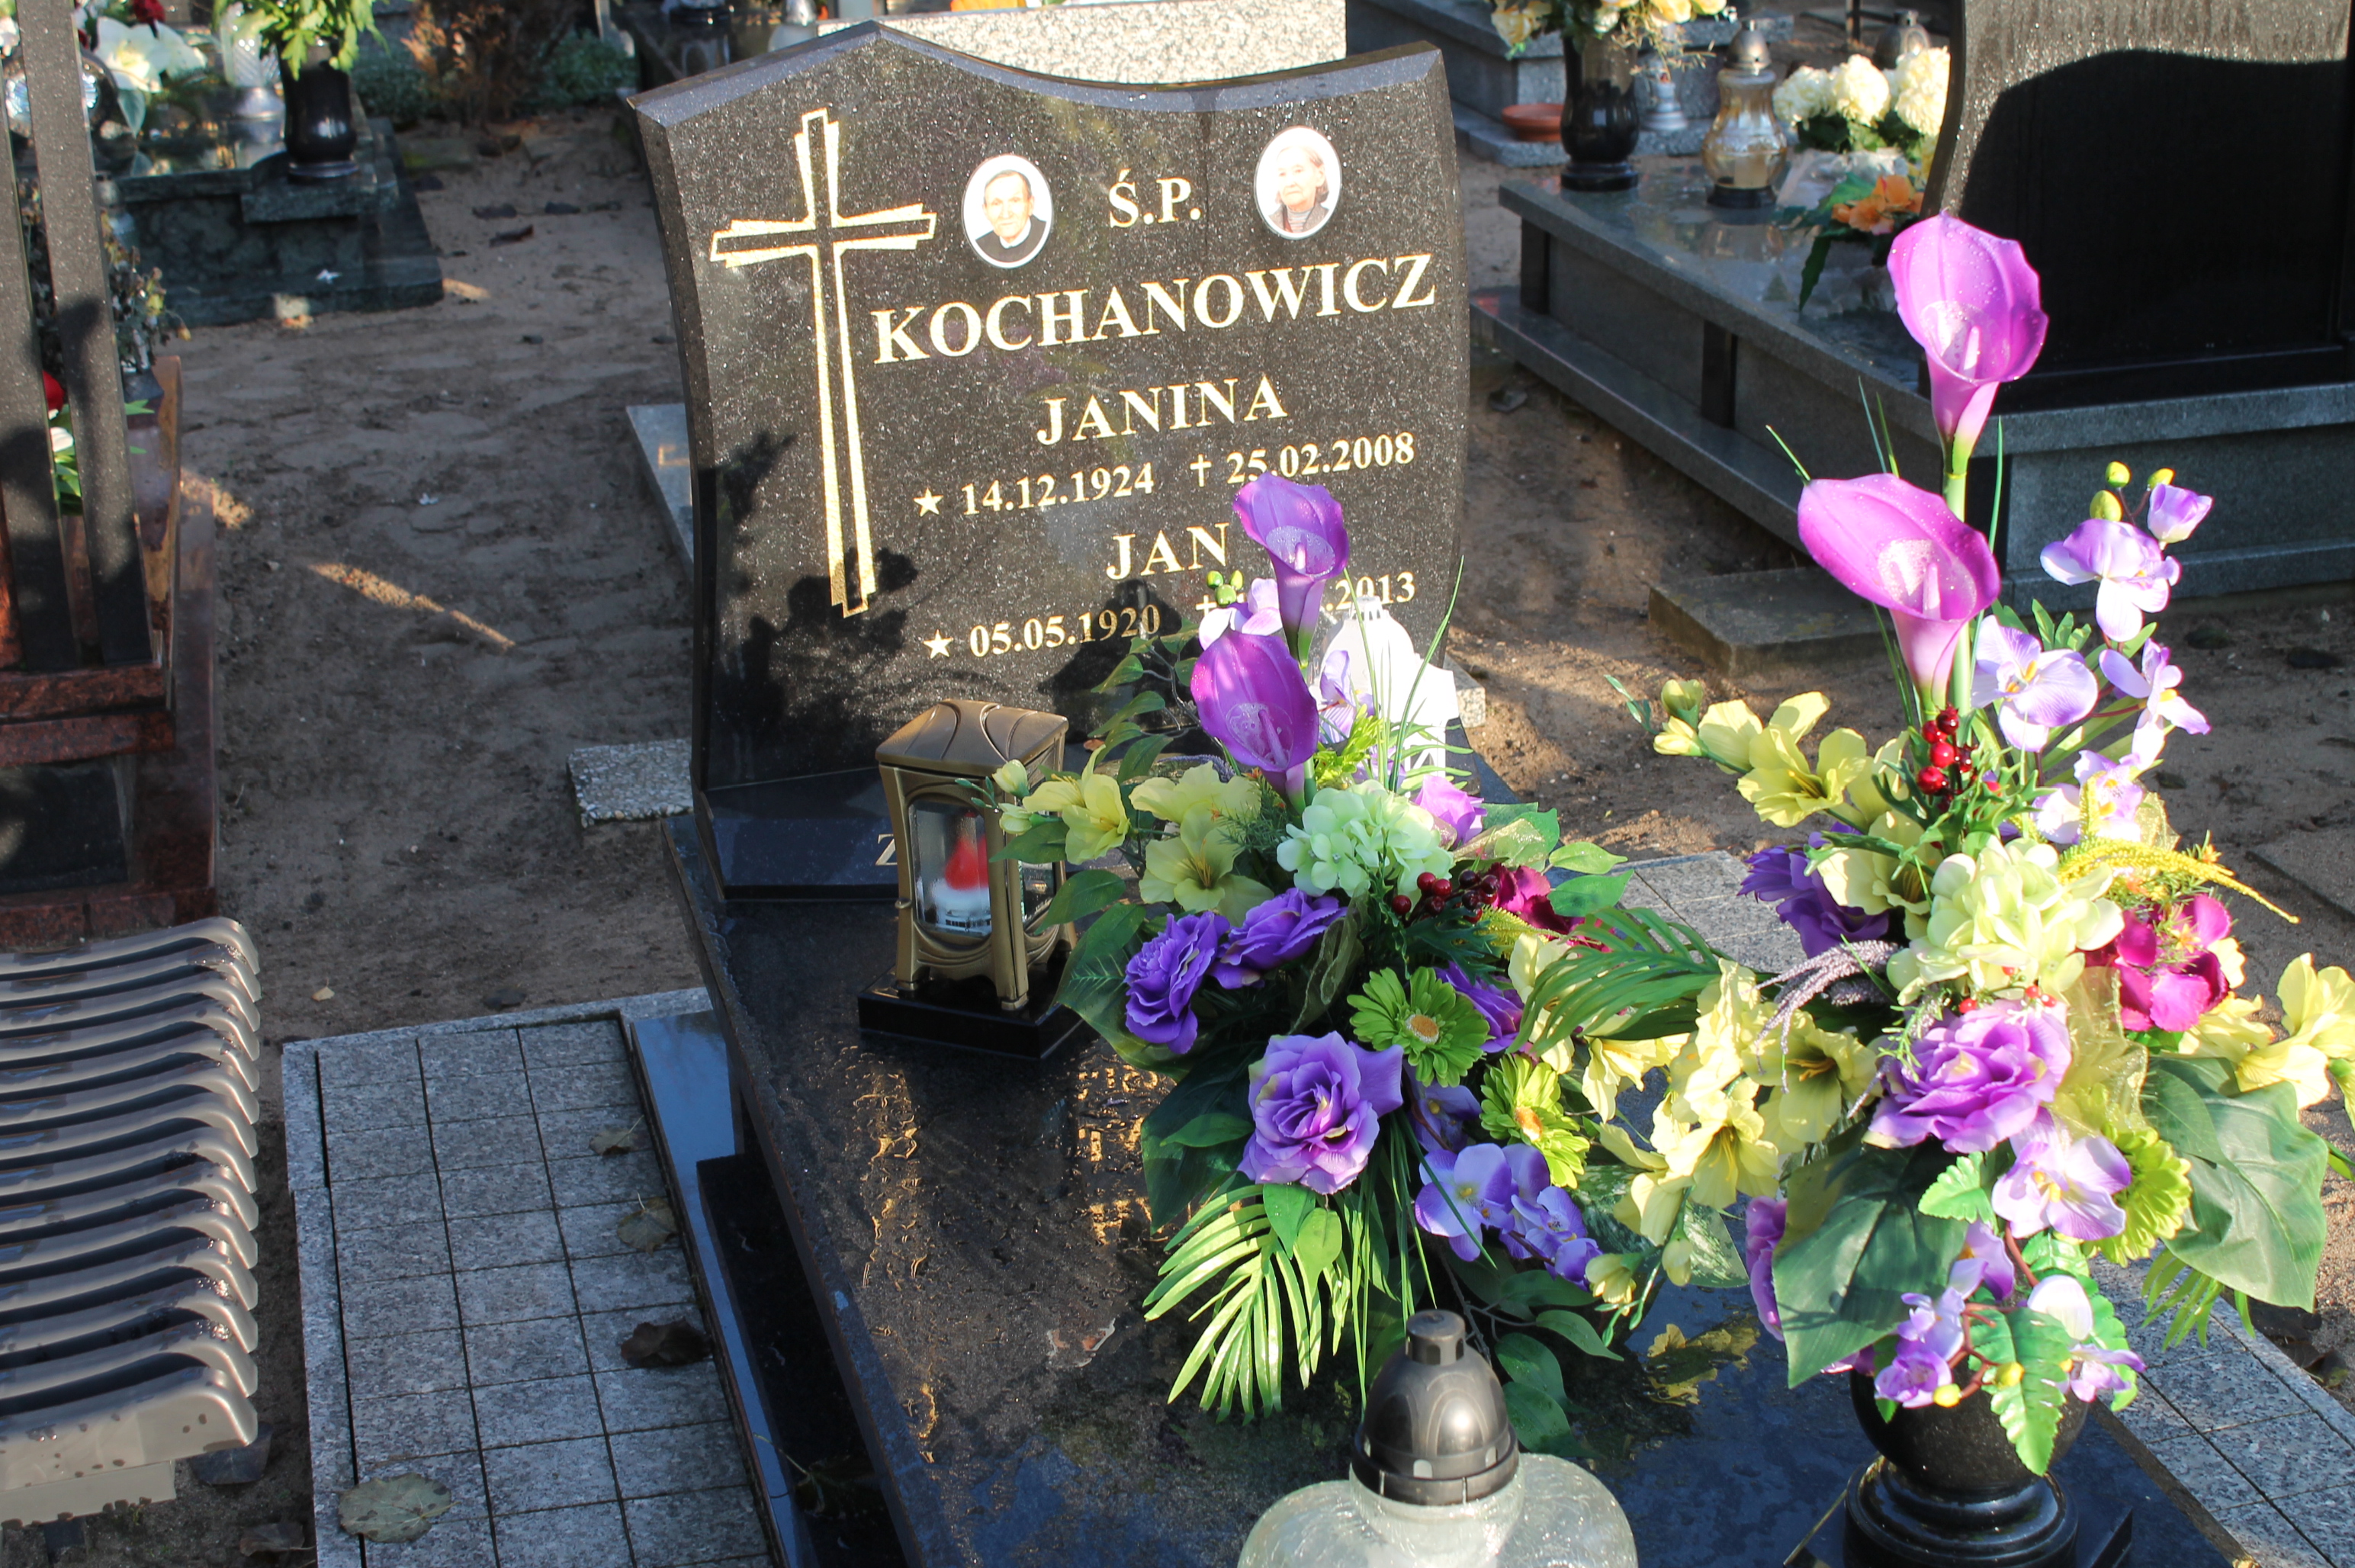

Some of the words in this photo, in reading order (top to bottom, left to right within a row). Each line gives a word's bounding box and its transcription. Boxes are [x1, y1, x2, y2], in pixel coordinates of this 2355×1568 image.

[1107, 169, 1203, 230] Ś.P.
[870, 252, 1437, 365] KOCHANOWICZ
[1036, 374, 1288, 446] JANINA
[961, 461, 1155, 516] 14.12.1924
[1226, 431, 1415, 484] 25.02.2008
[1106, 522, 1230, 580] JAN
[969, 604, 1161, 657] 05.05.1920
